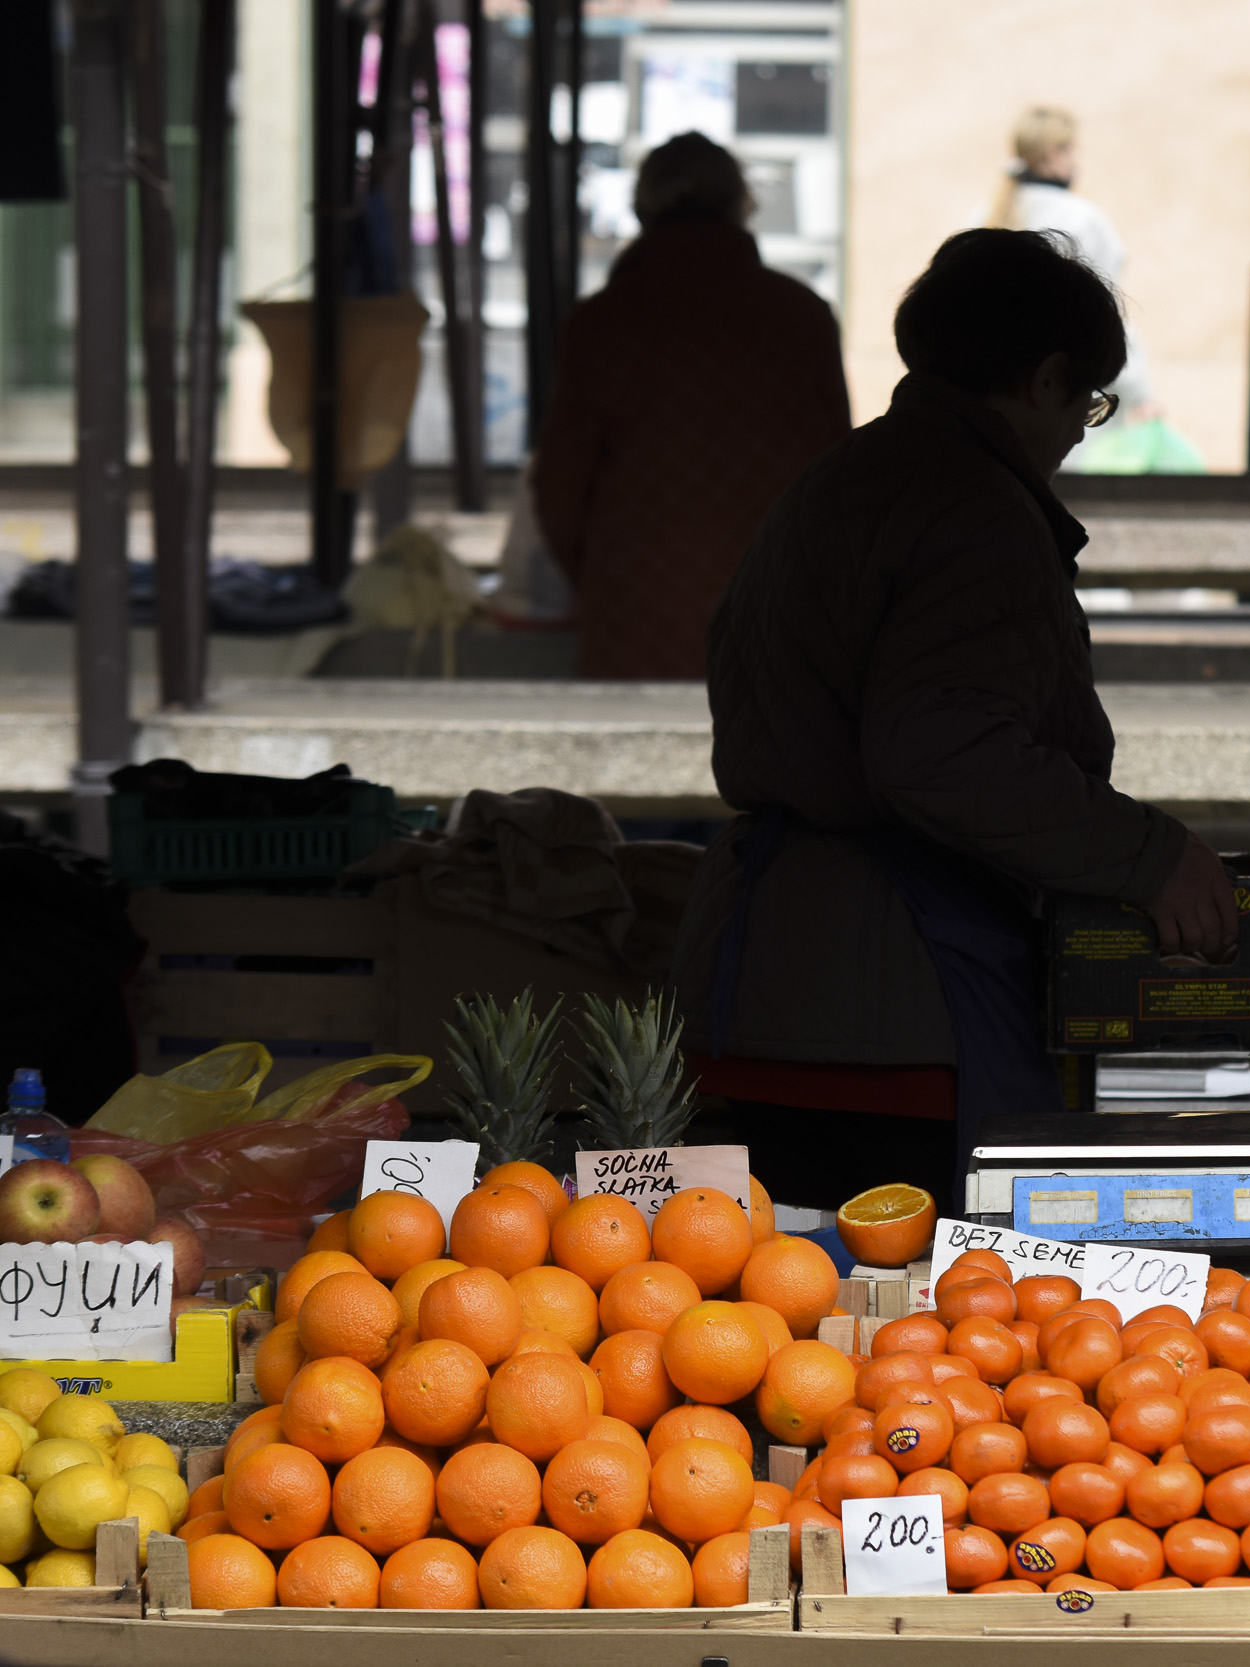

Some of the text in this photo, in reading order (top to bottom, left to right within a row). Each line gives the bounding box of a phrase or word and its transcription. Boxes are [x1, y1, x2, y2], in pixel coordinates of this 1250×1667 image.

[949, 1224, 1005, 1253] BEZ
[1012, 1240, 1086, 1270] SEME
[888, 1429, 917, 1446] ayhan
[1019, 1543, 1044, 1568] ayhan
[1059, 1590, 1093, 1603] ayhan
